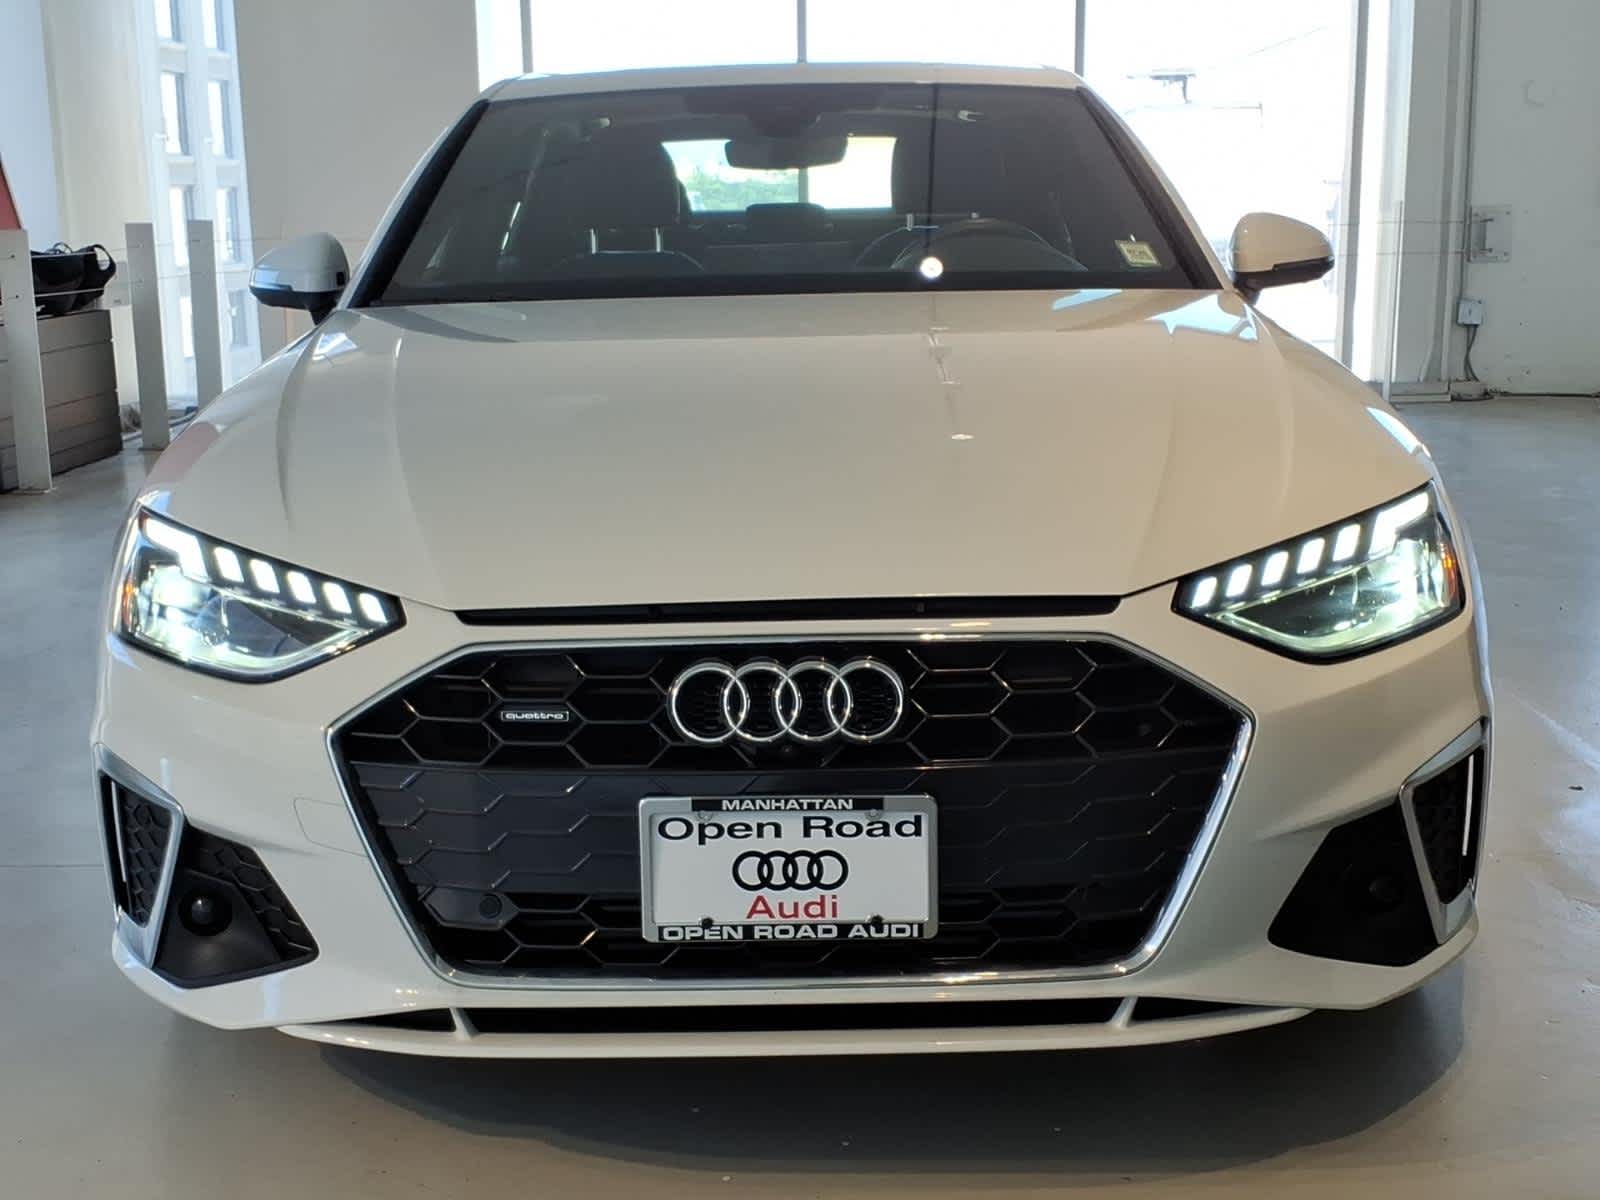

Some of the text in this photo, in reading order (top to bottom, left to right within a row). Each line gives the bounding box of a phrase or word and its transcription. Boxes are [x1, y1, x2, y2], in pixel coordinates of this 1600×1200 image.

[505, 712, 564, 720] quattro
[721, 799, 853, 811] MANHATTAN
[657, 815, 923, 845] Open Road
[746, 895, 839, 919] Audi
[662, 923, 919, 941] OPEN ROAD AUDI
